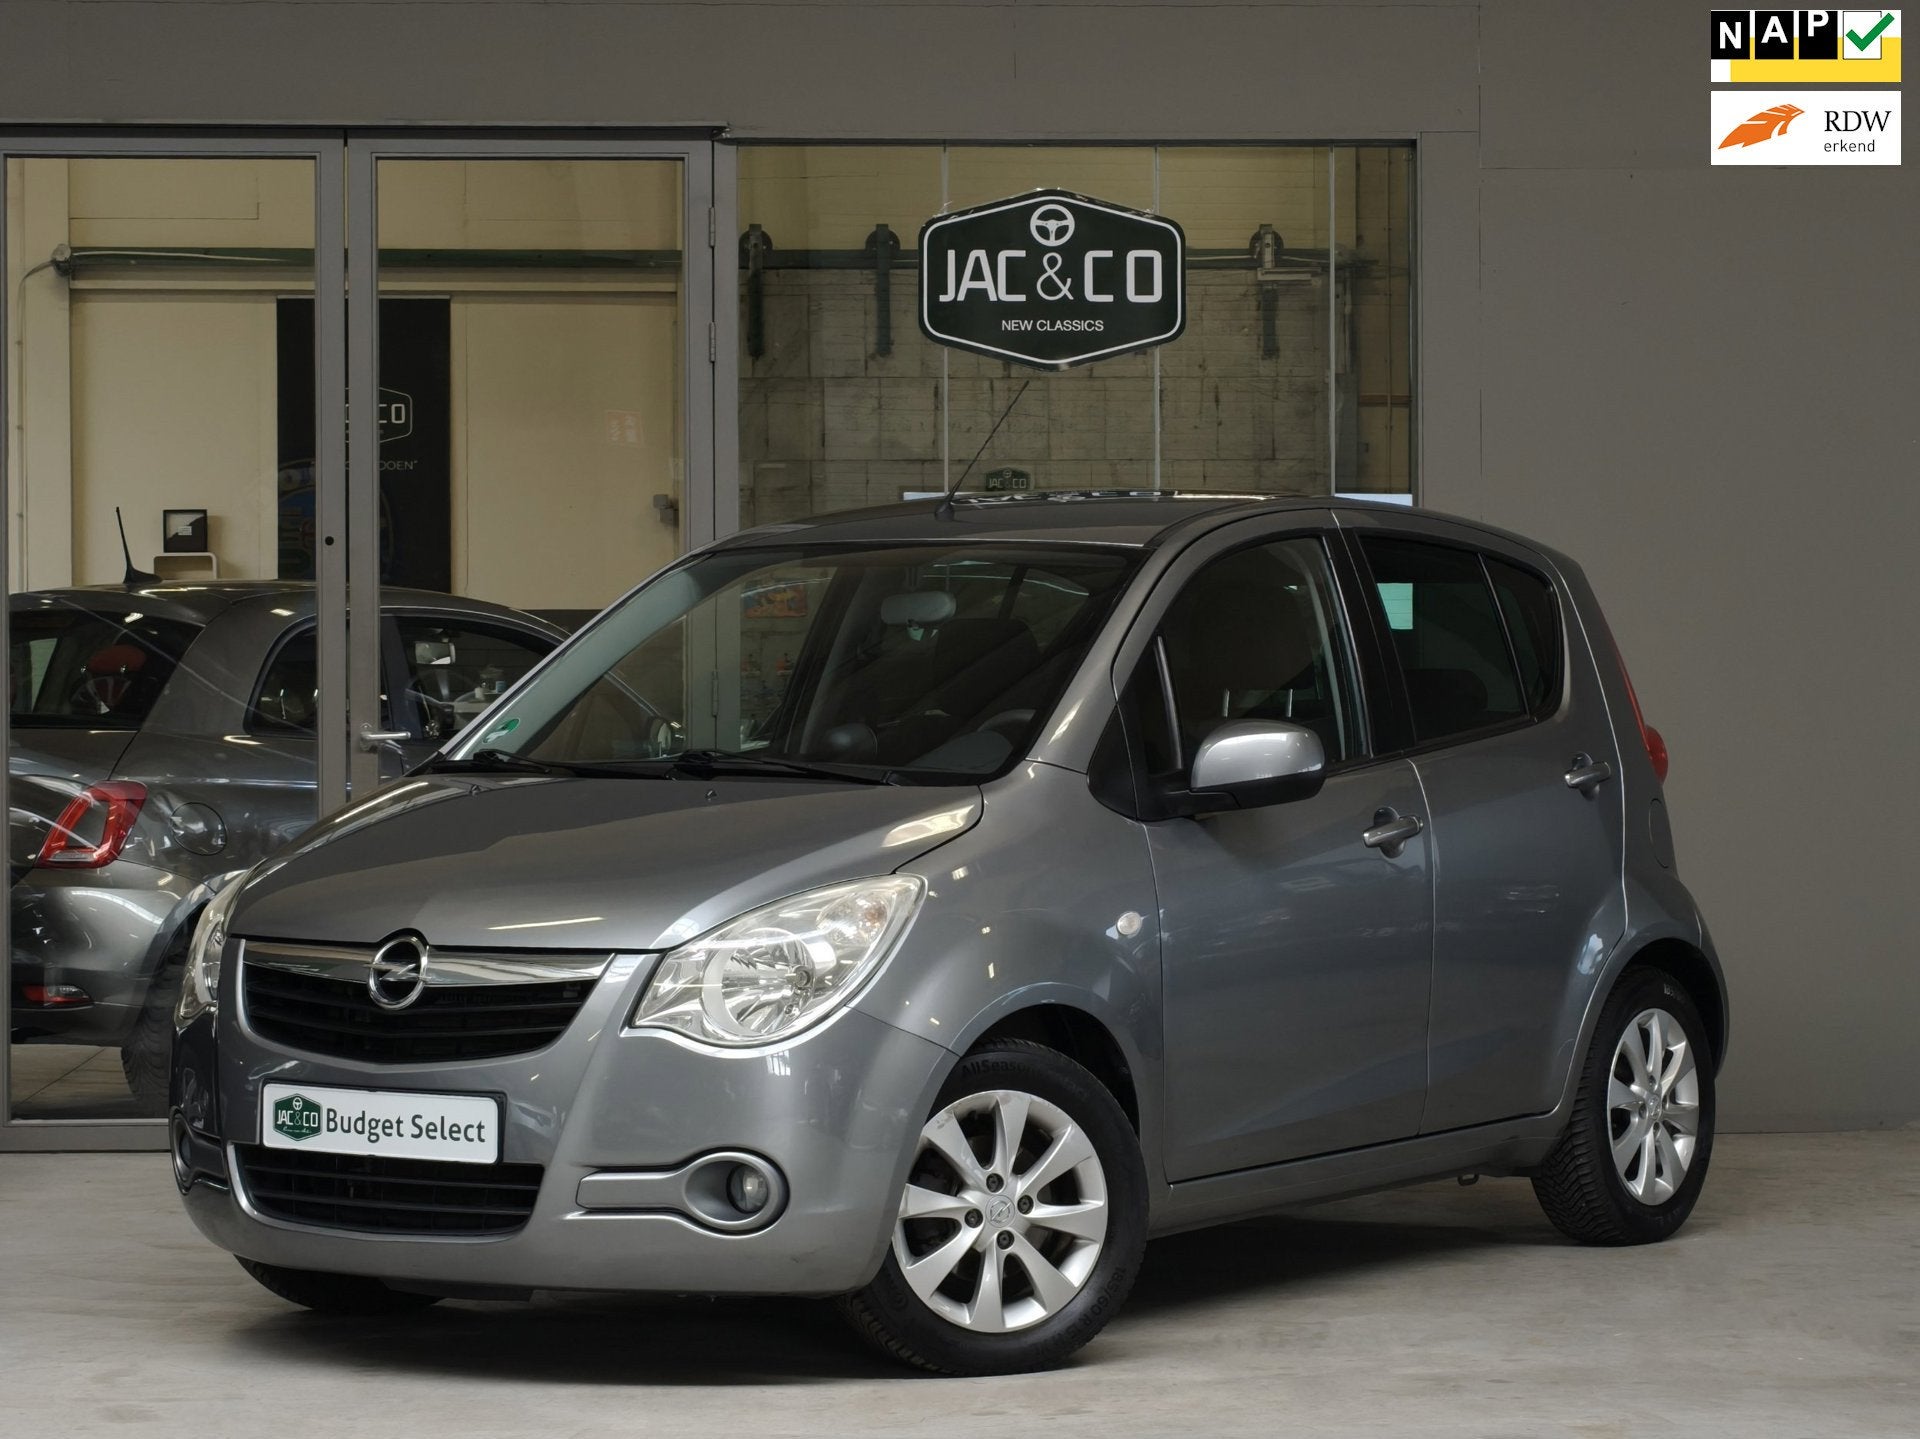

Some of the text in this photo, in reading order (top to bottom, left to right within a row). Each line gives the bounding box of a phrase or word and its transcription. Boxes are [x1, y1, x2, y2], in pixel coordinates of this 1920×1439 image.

[1001, 319, 1104, 332] NEW CLASSICS
[326, 1108, 486, 1144] Budget Select
